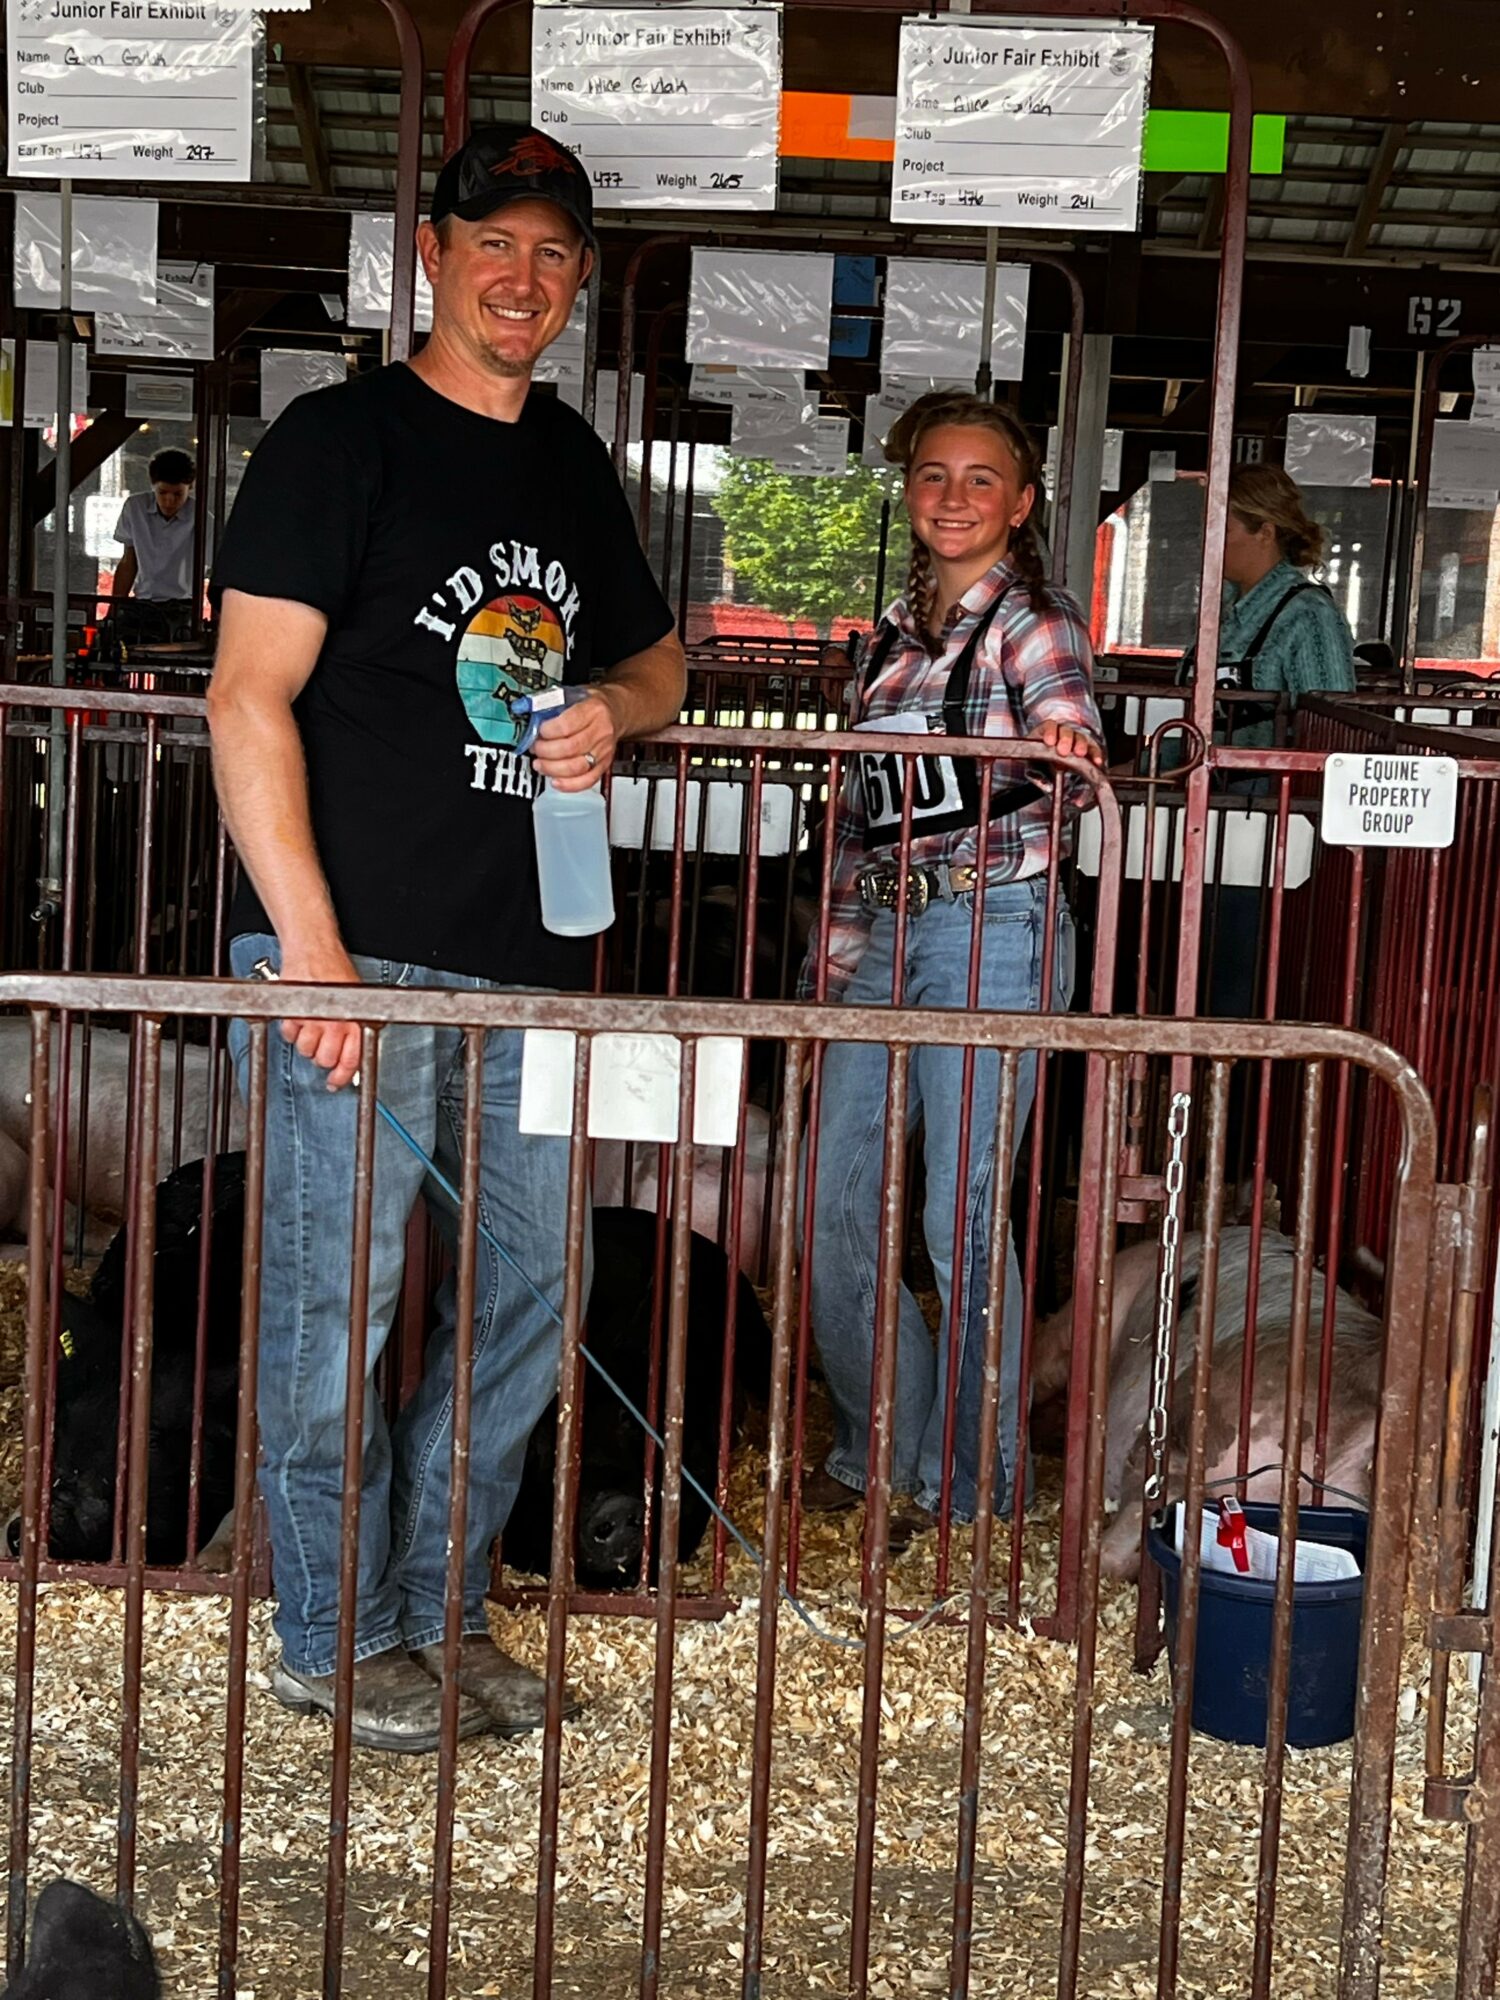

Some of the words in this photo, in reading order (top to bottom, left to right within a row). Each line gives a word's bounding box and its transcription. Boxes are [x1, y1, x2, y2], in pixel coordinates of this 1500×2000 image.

[51, 0, 106, 18] Junior
[110, 0, 142, 19] Fair
[148, 1, 206, 20] Exhibit
[576, 28, 630, 46] Junior
[636, 28, 667, 46] Fair
[673, 28, 732, 46] Exhibit
[16, 50, 50, 63] Name
[943, 47, 999, 65] Junior
[1003, 48, 1036, 66] Fair
[1041, 49, 1100, 67] Exhibit
[17, 81, 45, 94] Club
[540, 78, 574, 92] Name
[905, 96, 939, 110] Name
[18, 113, 59, 128] Project
[541, 110, 568, 123] Club
[18, 145, 37, 156] Ear
[41, 145, 62, 159] Tag
[133, 144, 174, 160] Weight
[185, 144, 215, 161] 297
[902, 158, 945, 175] Project
[593, 170, 623, 189] 477
[656, 173, 698, 189] Weight
[901, 190, 921, 201] Ear
[924, 190, 945, 206] Tag
[1016, 192, 1058, 208] Weight
[1069, 194, 1095, 210] 241
[1407, 296, 1462, 337] G2
[413, 565, 484, 643] I'D
[464, 743, 546, 800] THA
[1363, 757, 1420, 783] EQUINE
[1348, 783, 1432, 809] PROPERTY
[1362, 809, 1414, 834] GROUP
